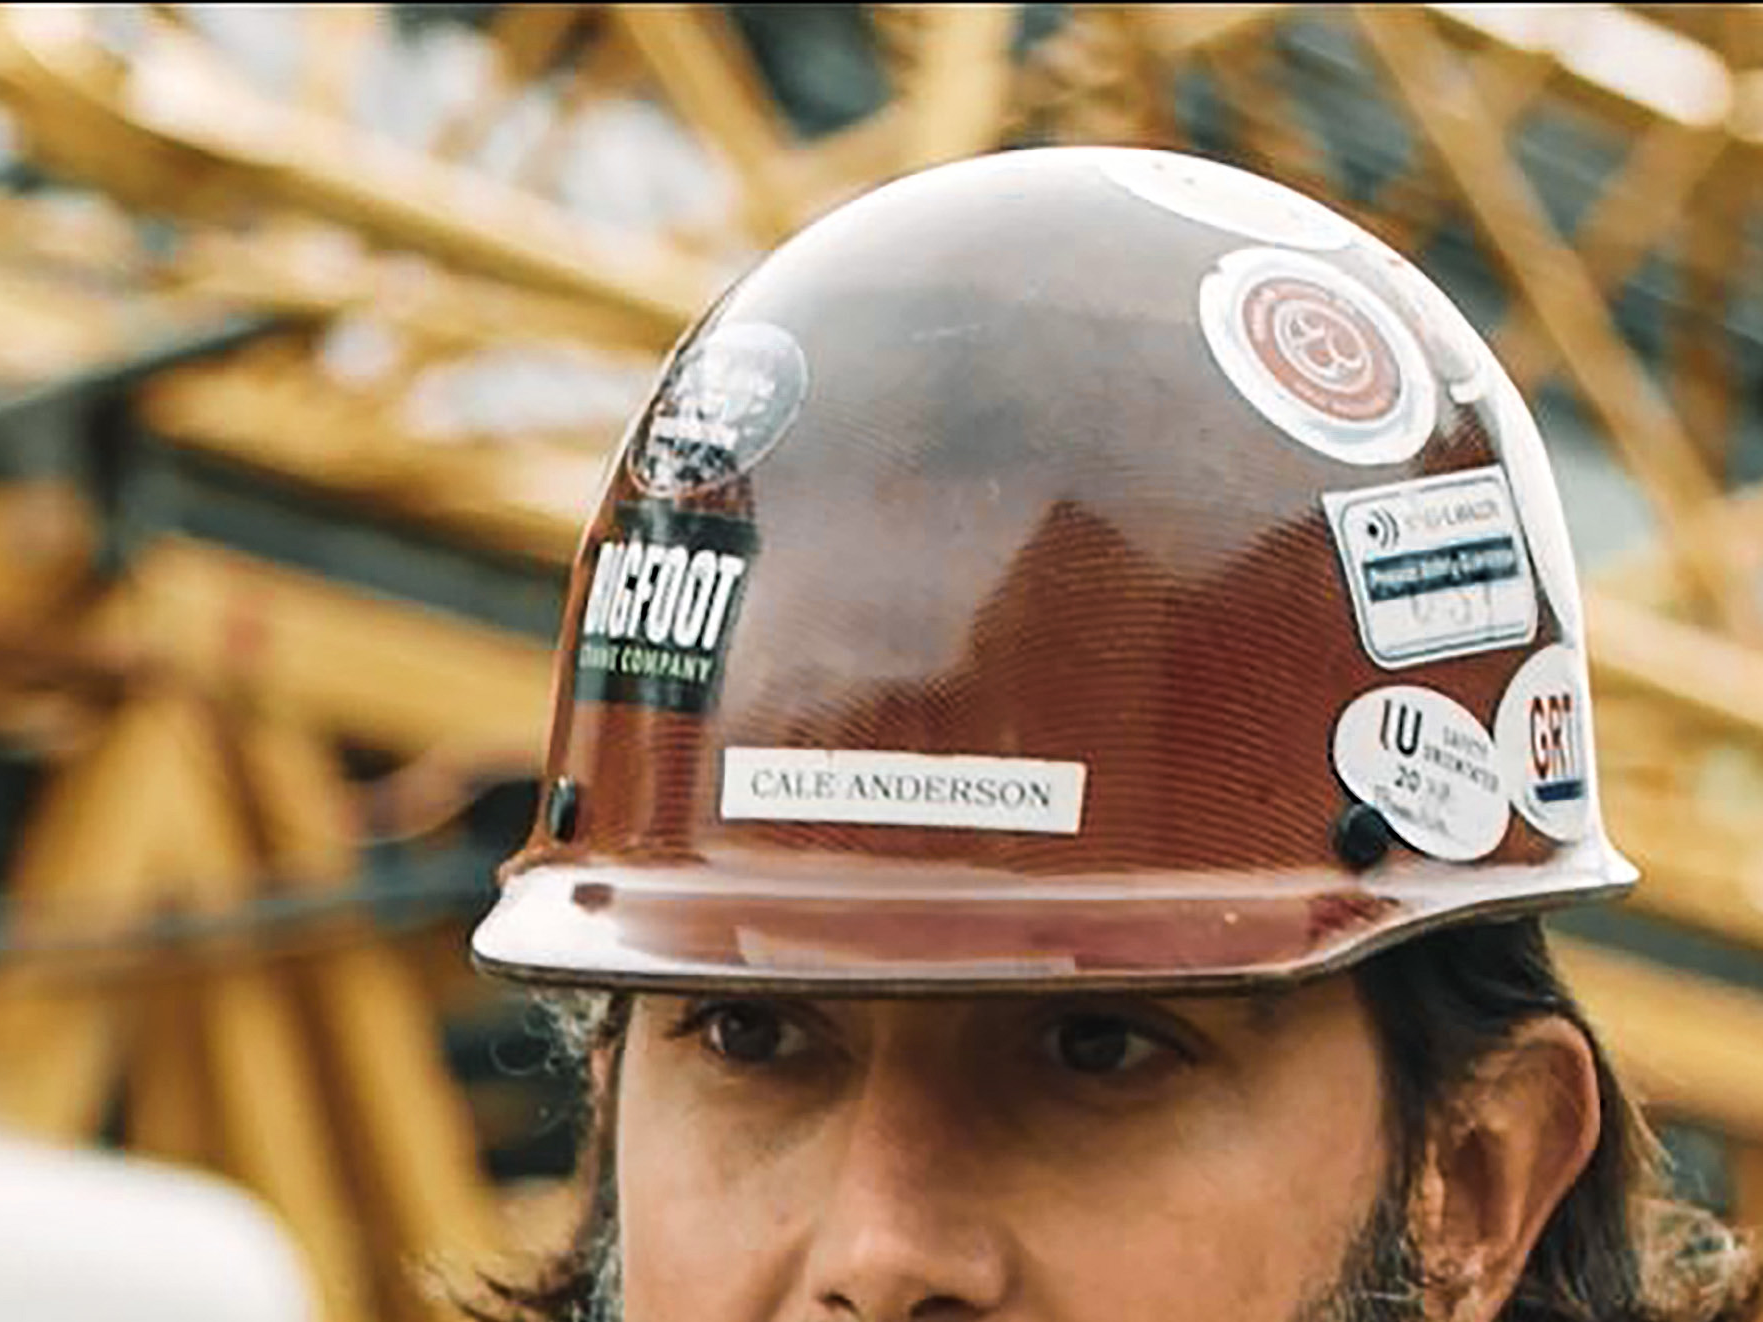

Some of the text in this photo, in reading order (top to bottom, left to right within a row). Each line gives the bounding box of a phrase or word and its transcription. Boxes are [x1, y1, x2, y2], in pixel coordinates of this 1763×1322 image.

[621, 648, 714, 684] COMPANY
[750, 768, 1052, 809] CALE ANDERSON
